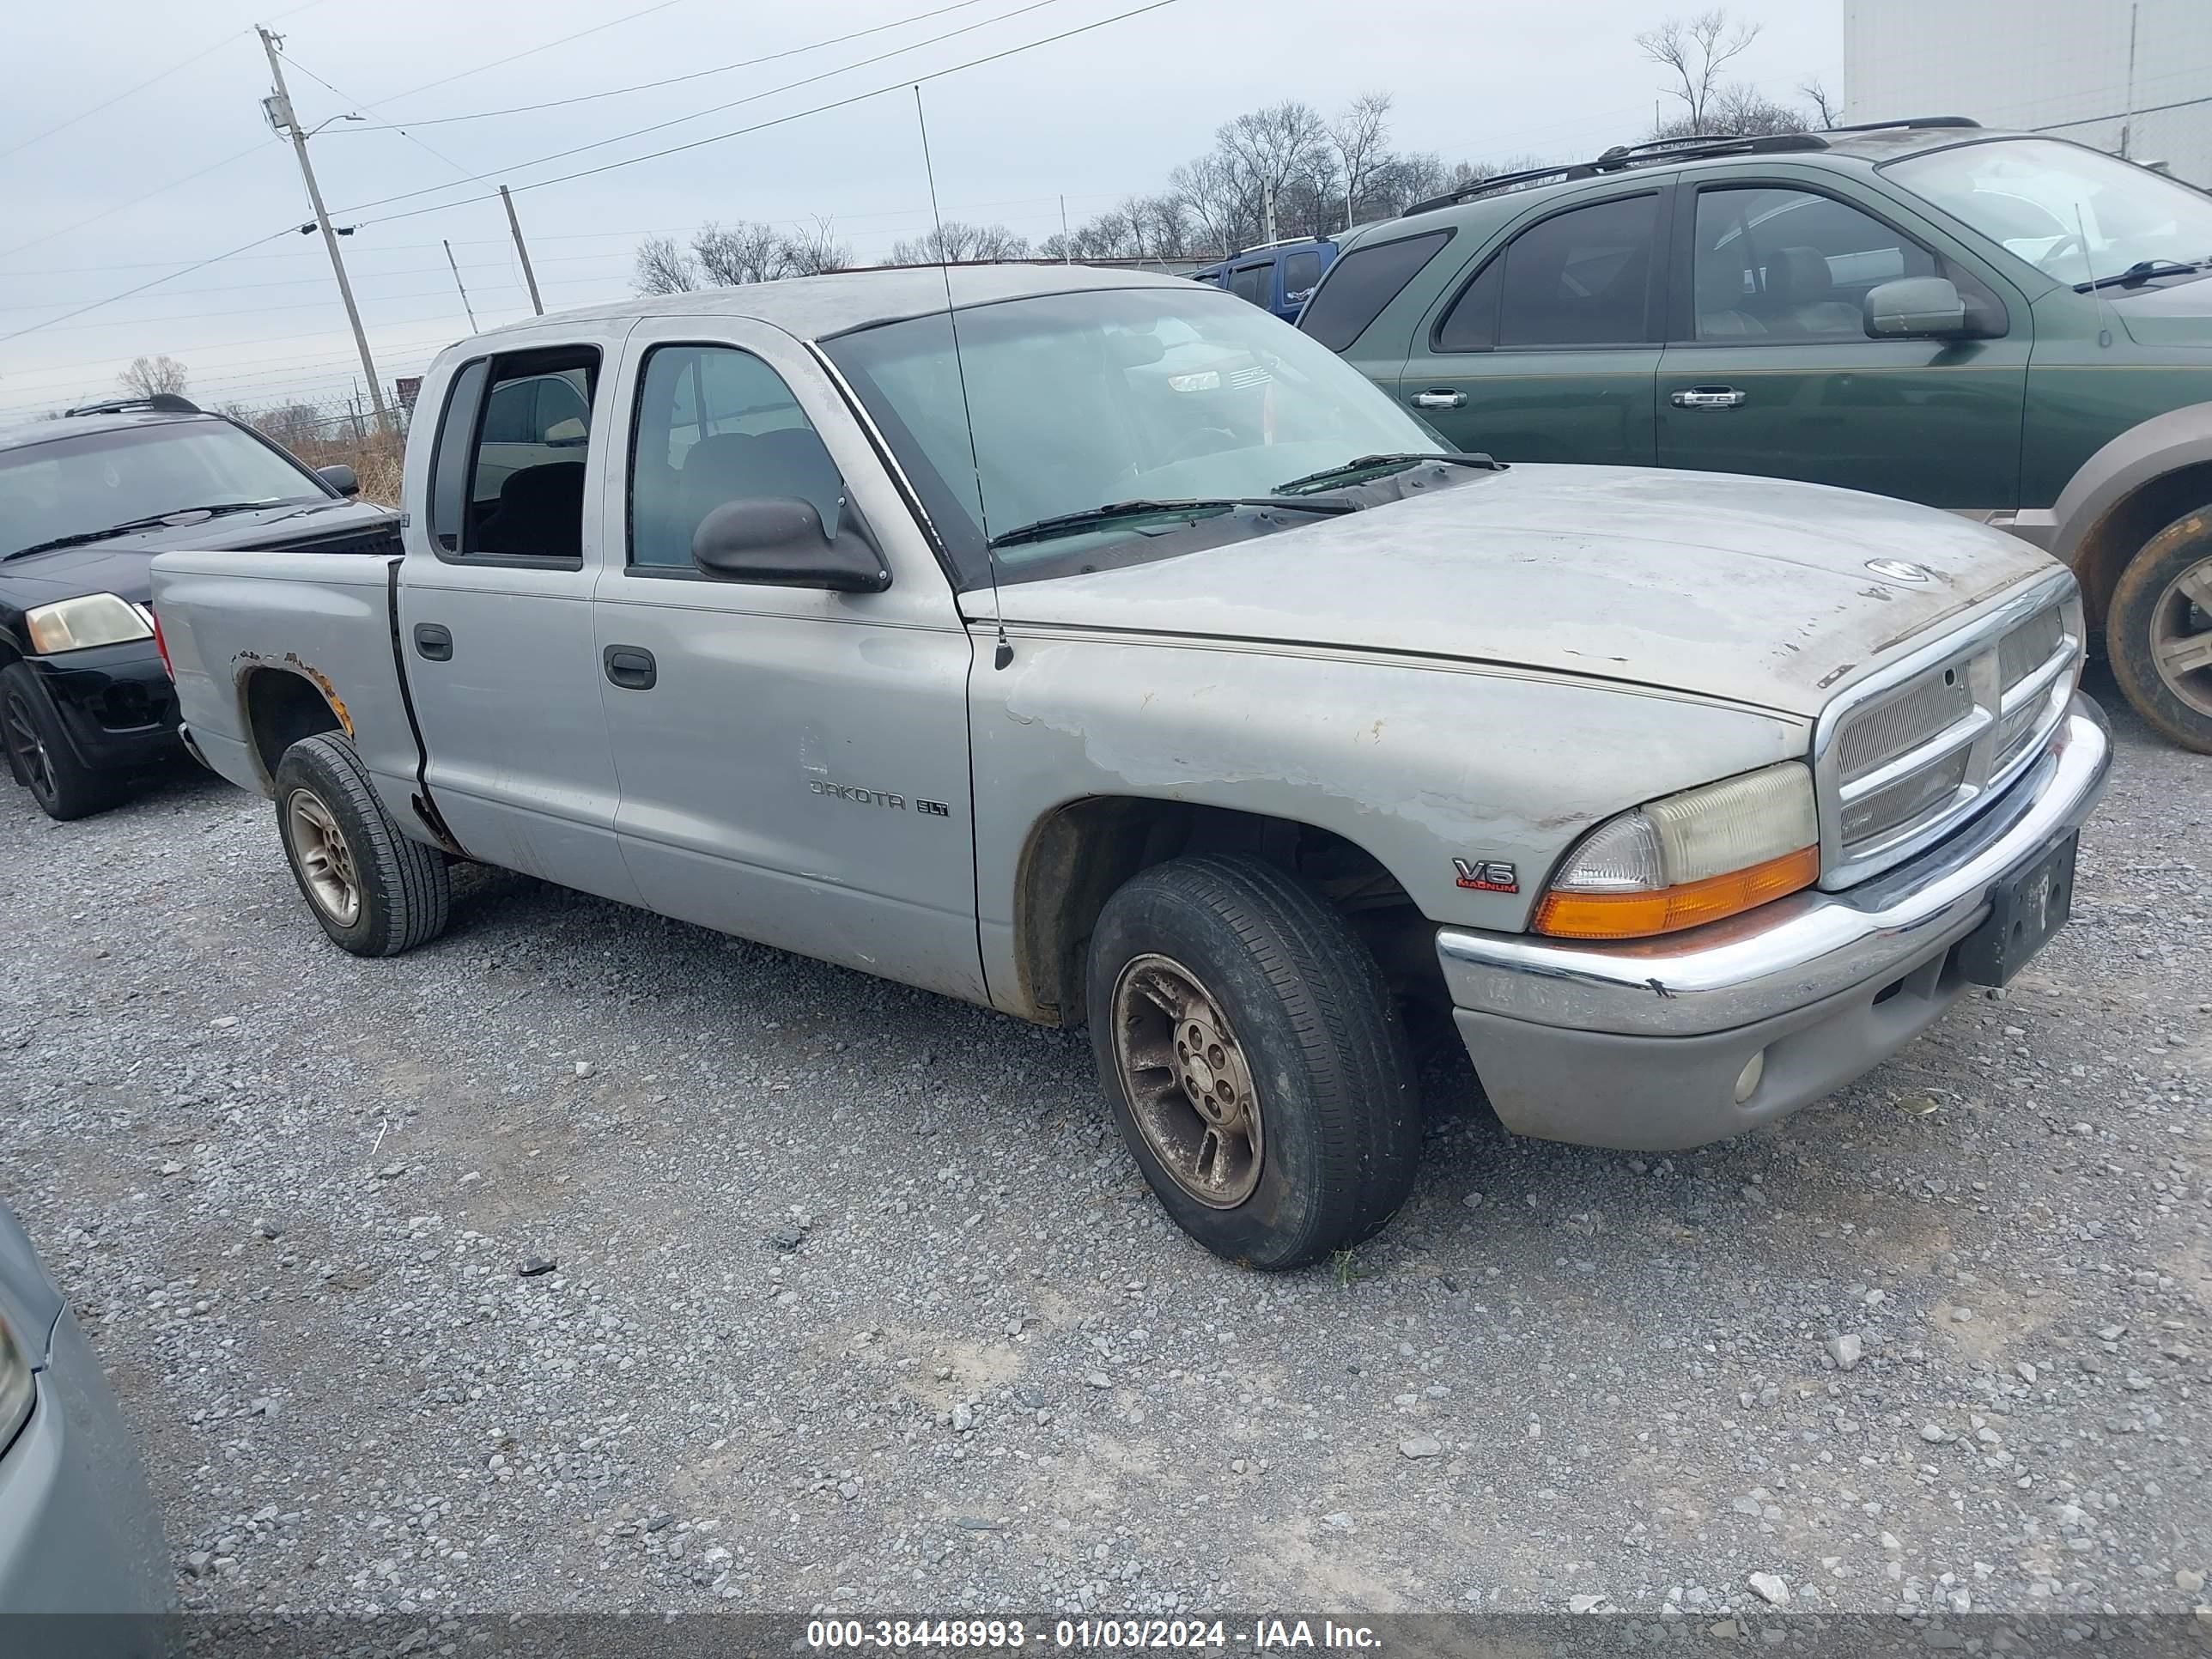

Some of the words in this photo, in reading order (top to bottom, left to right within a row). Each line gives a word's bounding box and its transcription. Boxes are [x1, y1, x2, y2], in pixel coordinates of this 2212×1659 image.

[810, 779, 907, 810] DAKOTA
[916, 798, 951, 817] SLT
[1452, 858, 1516, 884] V6
[1458, 879, 1517, 893] MAGNUM
